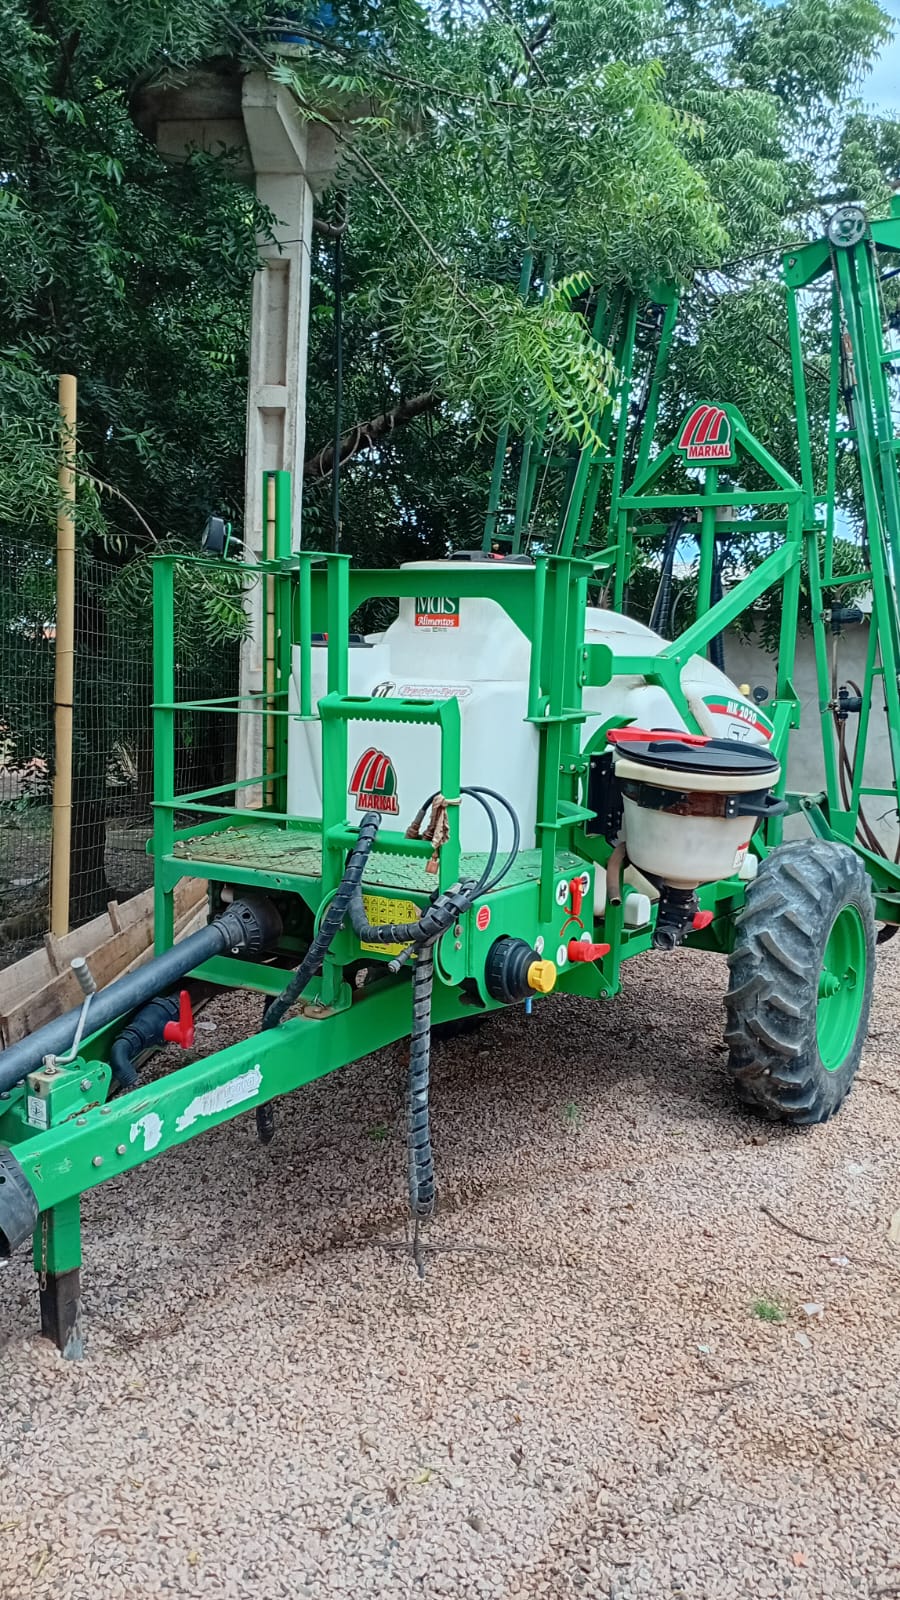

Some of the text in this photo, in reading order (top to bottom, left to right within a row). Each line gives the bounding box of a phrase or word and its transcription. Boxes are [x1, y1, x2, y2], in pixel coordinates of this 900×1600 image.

[688, 445, 730, 458] MARKAL
[417, 614, 455, 626] Alimentos
[738, 705, 757, 725] 2020
[358, 793, 397, 812] MARKAL
